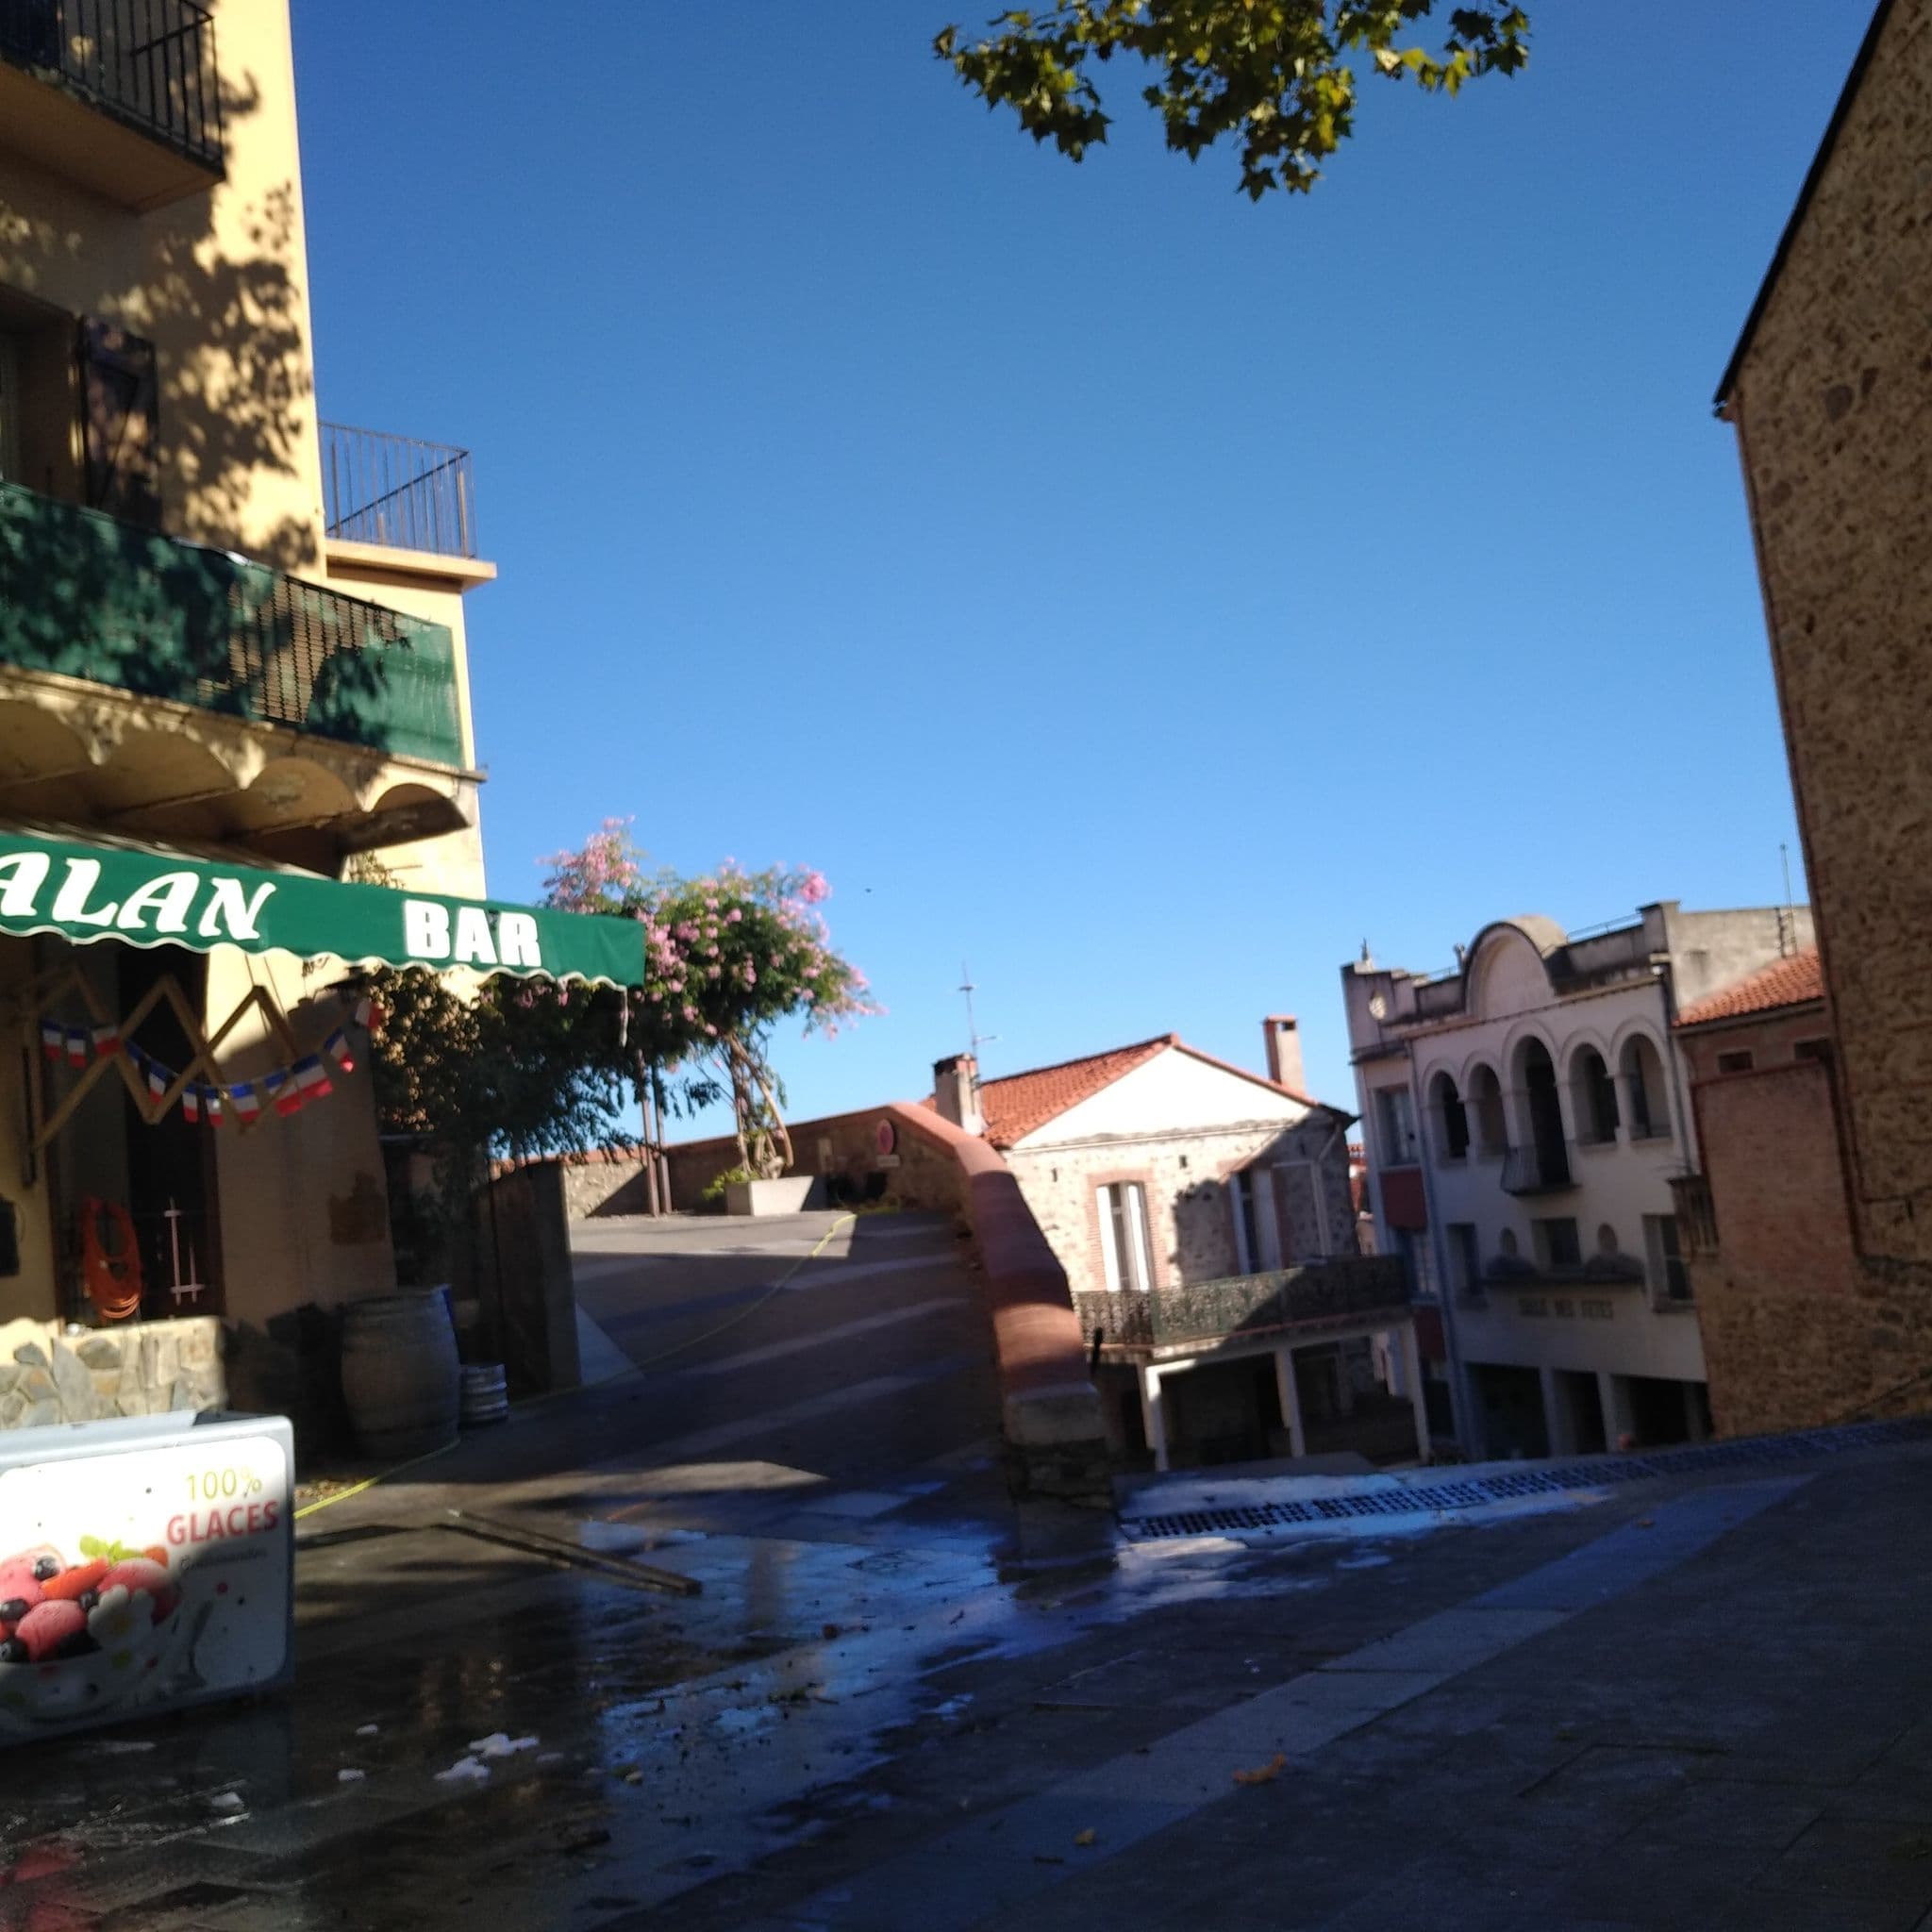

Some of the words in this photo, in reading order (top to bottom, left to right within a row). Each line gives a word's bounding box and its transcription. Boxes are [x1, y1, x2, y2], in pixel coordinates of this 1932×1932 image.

[404, 899, 541, 968] BAR
[187, 1466, 262, 1500] 100%
[167, 1501, 279, 1544] GLACES
